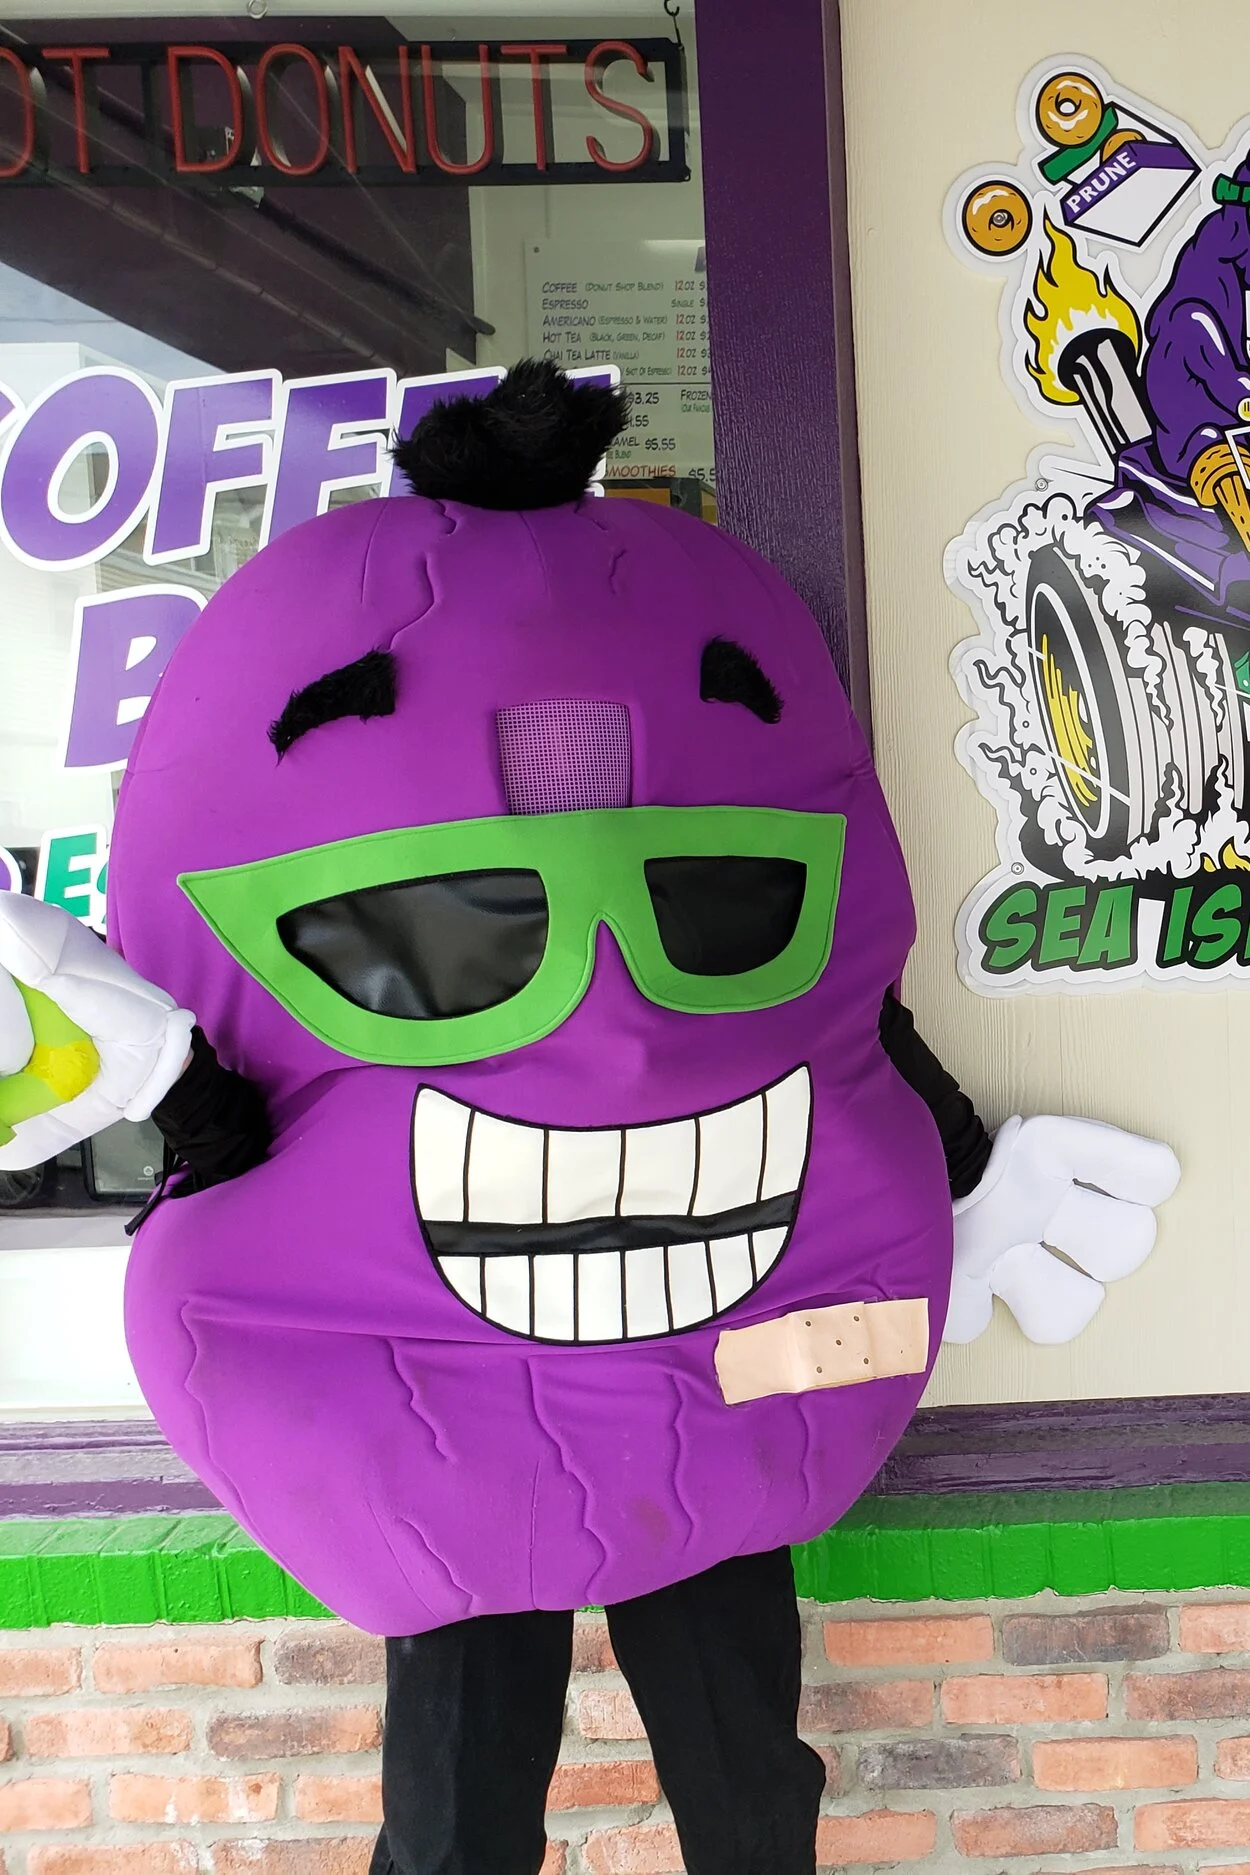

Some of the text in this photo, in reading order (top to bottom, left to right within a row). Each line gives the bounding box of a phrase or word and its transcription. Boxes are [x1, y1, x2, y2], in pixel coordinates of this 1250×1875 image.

[167, 41, 654, 176] DONUTS
[1066, 152, 1136, 213] PRUNE
[542, 281, 578, 294] COFFEE
[542, 298, 589, 310] ESPRESSO
[543, 315, 596, 327] AMERICANO
[543, 331, 562, 344] HOT
[565, 331, 582, 344] TEA
[566, 349, 582, 361] TEA
[585, 348, 611, 361] LATTE
[680, 389, 712, 401] FROZEN
[645, 438, 676, 451] $5.55
[981, 879, 1136, 971] SEA
